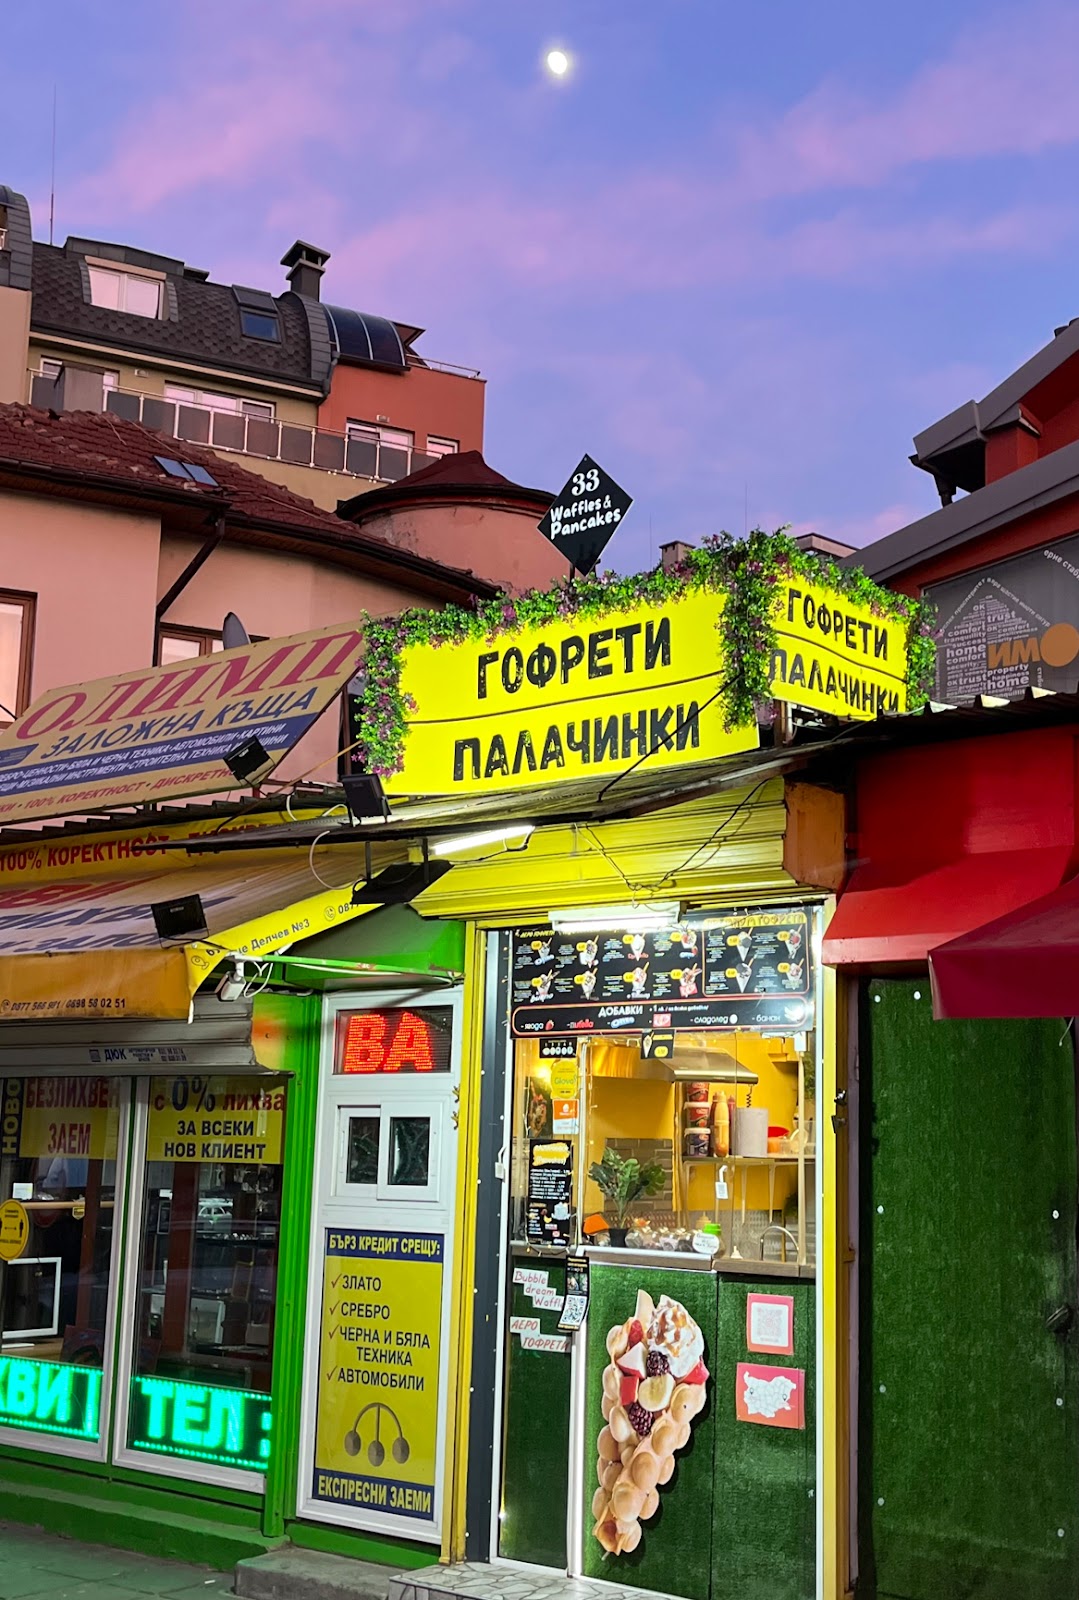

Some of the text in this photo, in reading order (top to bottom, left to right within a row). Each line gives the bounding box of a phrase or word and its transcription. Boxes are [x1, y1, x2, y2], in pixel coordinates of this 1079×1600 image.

[571, 468, 600, 496] 33
[550, 494, 611, 522] Waffles &
[550, 508, 621, 540] Pancakes
[787, 588, 888, 661] ГОФРЕТИ
[987, 611, 1016, 622] trust
[948, 623, 986, 637] comfort
[946, 643, 987, 658] home
[952, 638, 987, 648] success
[477, 616, 671, 700] ГОФРЕТИ
[946, 652, 987, 665] comfort
[959, 673, 987, 685] trust
[987, 664, 1029, 676] property
[16, 630, 363, 739] ОЛИМП
[769, 649, 899, 713] ПАЛАЧИНКИ
[987, 676, 1030, 690] home
[41, 686, 319, 759] ЗАЛОЖНА КЪЩА
[453, 701, 700, 781] ПАЛАЧИНКИ
[57, 781, 147, 804] КОРЕКТНОСТ
[0, 836, 170, 871] 100% КОРЕКТНОСТ
[251, 928, 290, 951] Делчев
[291, 918, 310, 933] №3
[101, 999, 112, 1008] 02
[115, 998, 126, 1008] 51
[598, 1006, 643, 1018] ДОБАВКИ
[694, 1015, 729, 1025] сладолед
[756, 1014, 781, 1023] банан
[104, 1048, 127, 1062] ДЮК
[154, 1077, 285, 1112] с 0% лихва
[2, 1079, 20, 1154] НОВО
[177, 1121, 254, 1136] ЗА ВСЕКИ
[47, 1122, 92, 1155] ЗАЕМ
[164, 1142, 266, 1159] НОВ КЛИЕНТ
[329, 1234, 441, 1256] БЪРЗ КРЕДИТ СРЕЩУ:
[342, 1275, 382, 1292] ЗЛАТО
[514, 1270, 547, 1285] Bubble
[525, 1284, 554, 1296] dream
[340, 1302, 390, 1320] СРЕБРО
[511, 1320, 538, 1331] АЕРО
[340, 1326, 431, 1349] ЧЕРНА И БЯЛА
[523, 1336, 570, 1351] ГОФРЕТИ
[356, 1346, 413, 1367] ТЕХНИКА
[337, 1367, 425, 1391] АВТОМОБИЛИ
[318, 1474, 432, 1514] ЕКСПРЕСНИ ЗАЕМИ
